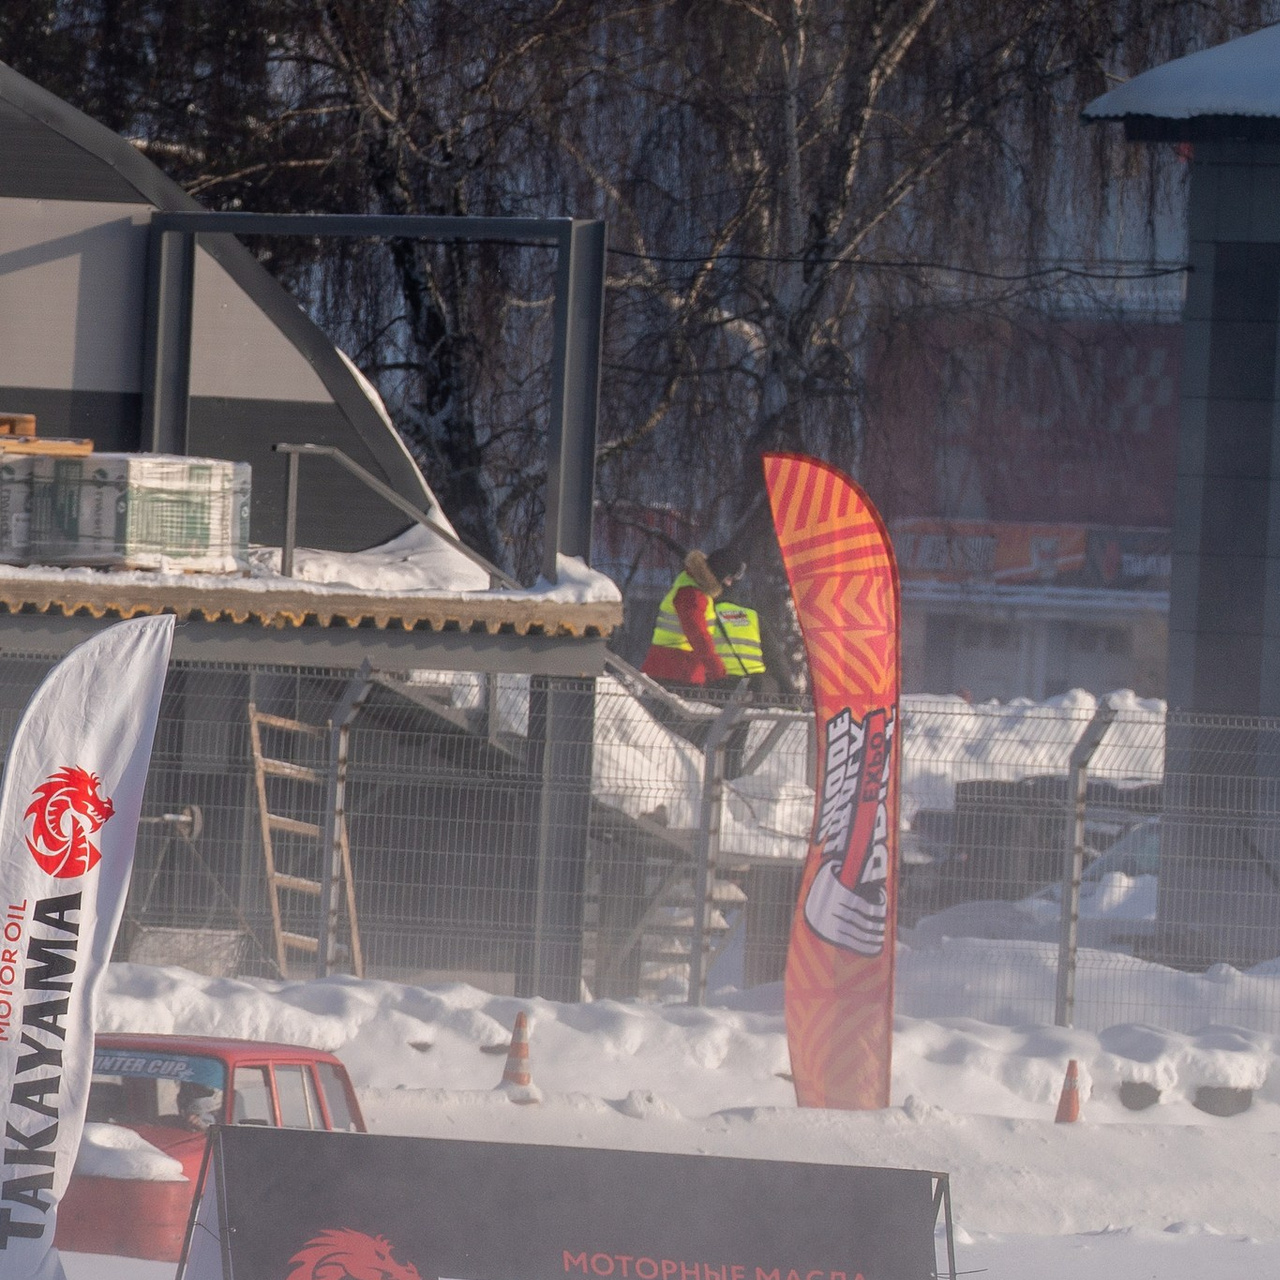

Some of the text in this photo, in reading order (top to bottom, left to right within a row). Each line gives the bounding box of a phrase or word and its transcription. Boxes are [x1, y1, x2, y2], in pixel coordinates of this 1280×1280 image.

[3, 898, 28, 943] OIL
[94, 1055, 188, 1076] INTER CUP
